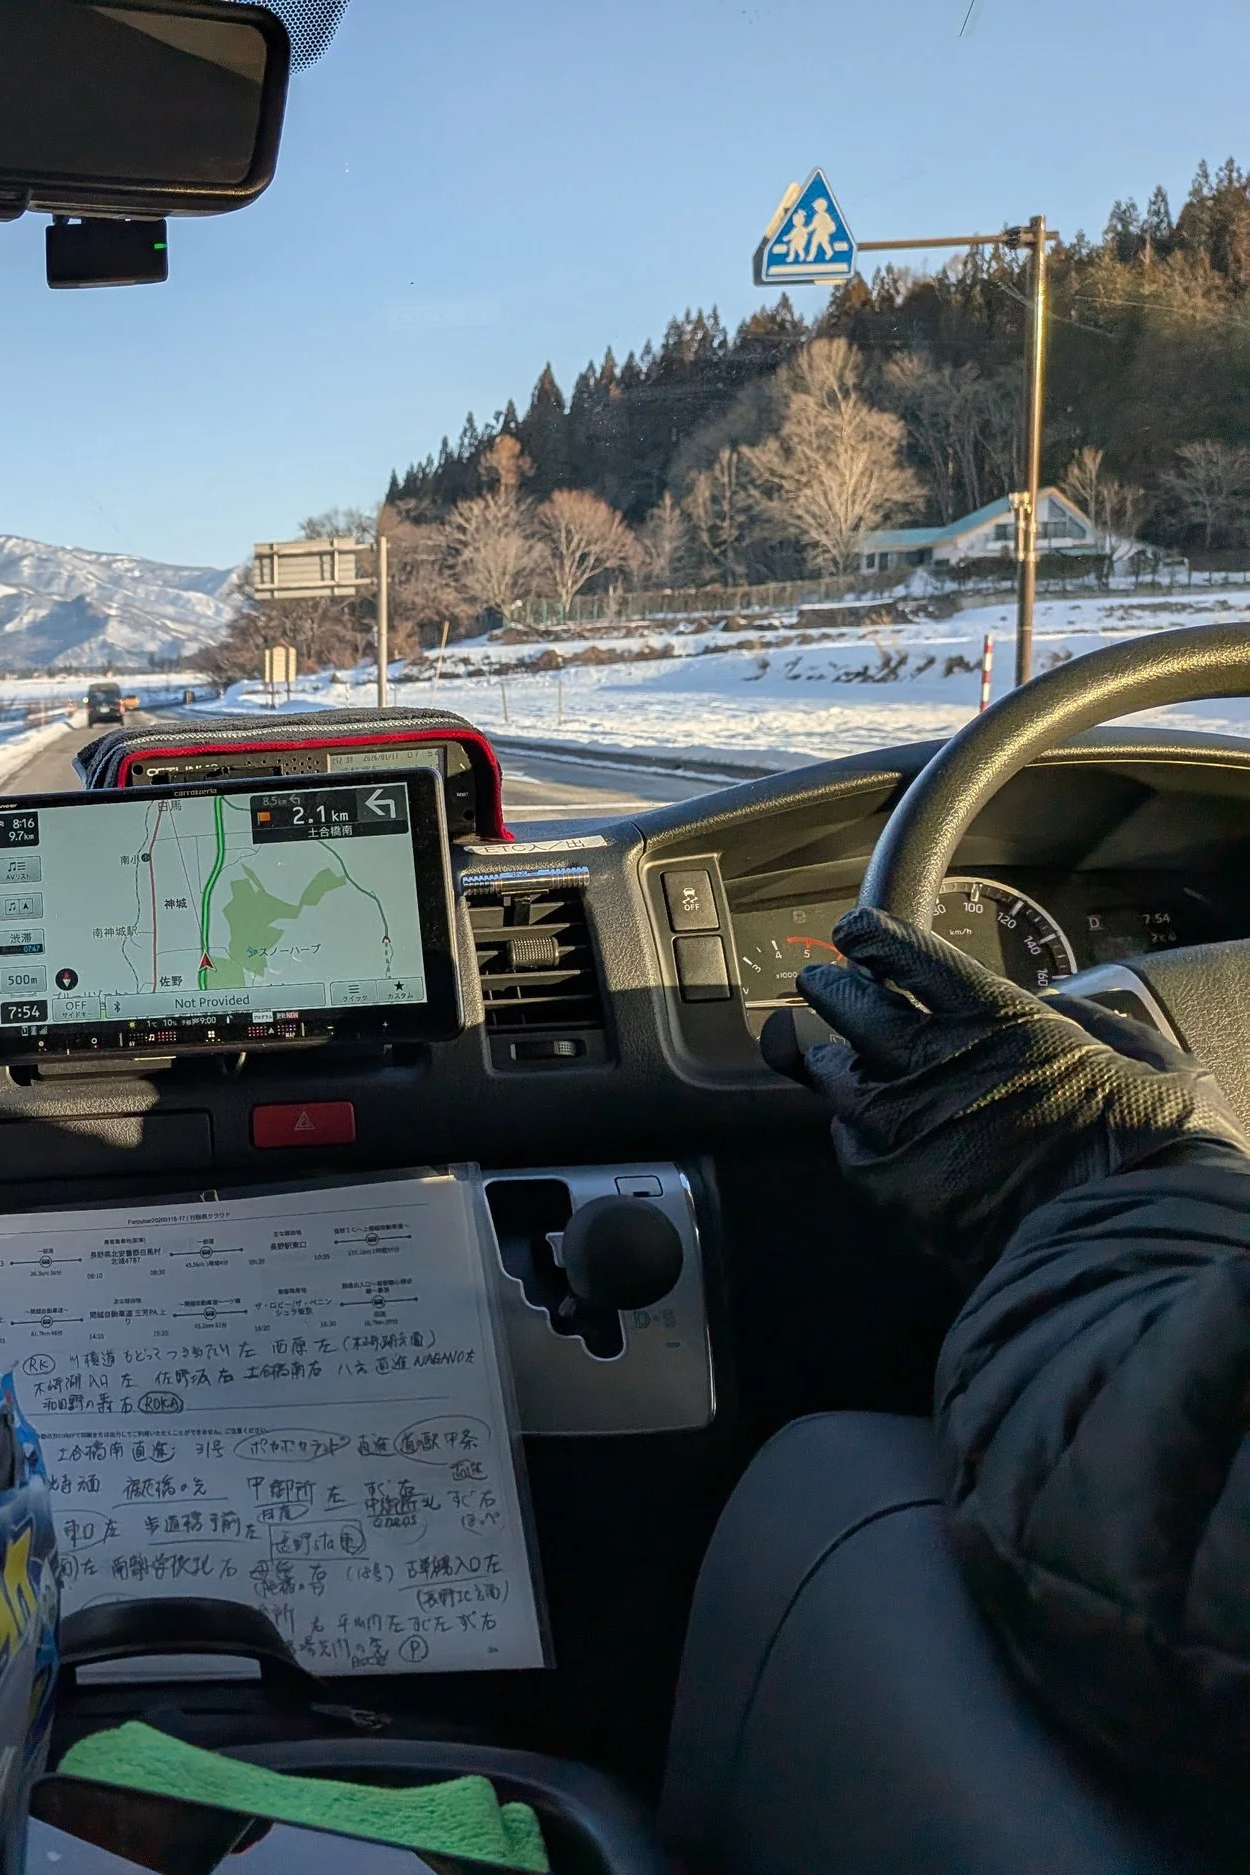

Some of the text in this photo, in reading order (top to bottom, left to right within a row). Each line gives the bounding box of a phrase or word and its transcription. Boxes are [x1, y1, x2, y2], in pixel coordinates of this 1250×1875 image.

[174, 788, 218, 796] carrozzeria
[158, 800, 182, 812] 白馬
[292, 805, 349, 825] 2.1 km
[12, 818, 35, 829] 8:16
[8, 830, 34, 842] 9.7km
[164, 897, 188, 910] 神城
[684, 903, 700, 912] OFF
[963, 902, 984, 914] 100
[998, 912, 1017, 930] 120
[10, 932, 32, 944] 渋滞
[92, 926, 138, 939] 南神城駅
[1023, 936, 1042, 956] 140
[775, 950, 782, 960] 4
[804, 950, 810, 958] 5
[752, 964, 762, 973] 3
[8, 974, 38, 986] 500m
[159, 975, 182, 988] 佐野
[1038, 968, 1048, 988] 160
[174, 994, 250, 1008] Not Provided
[387, 991, 414, 1000] カスタム
[65, 1001, 88, 1011] OFF
[8, 1005, 40, 1020] 7:54
[30, 1359, 49, 1370] RK
[238, 1341, 257, 1358] 左
[315, 1338, 338, 1354] 左
[121, 1372, 136, 1388] 左
